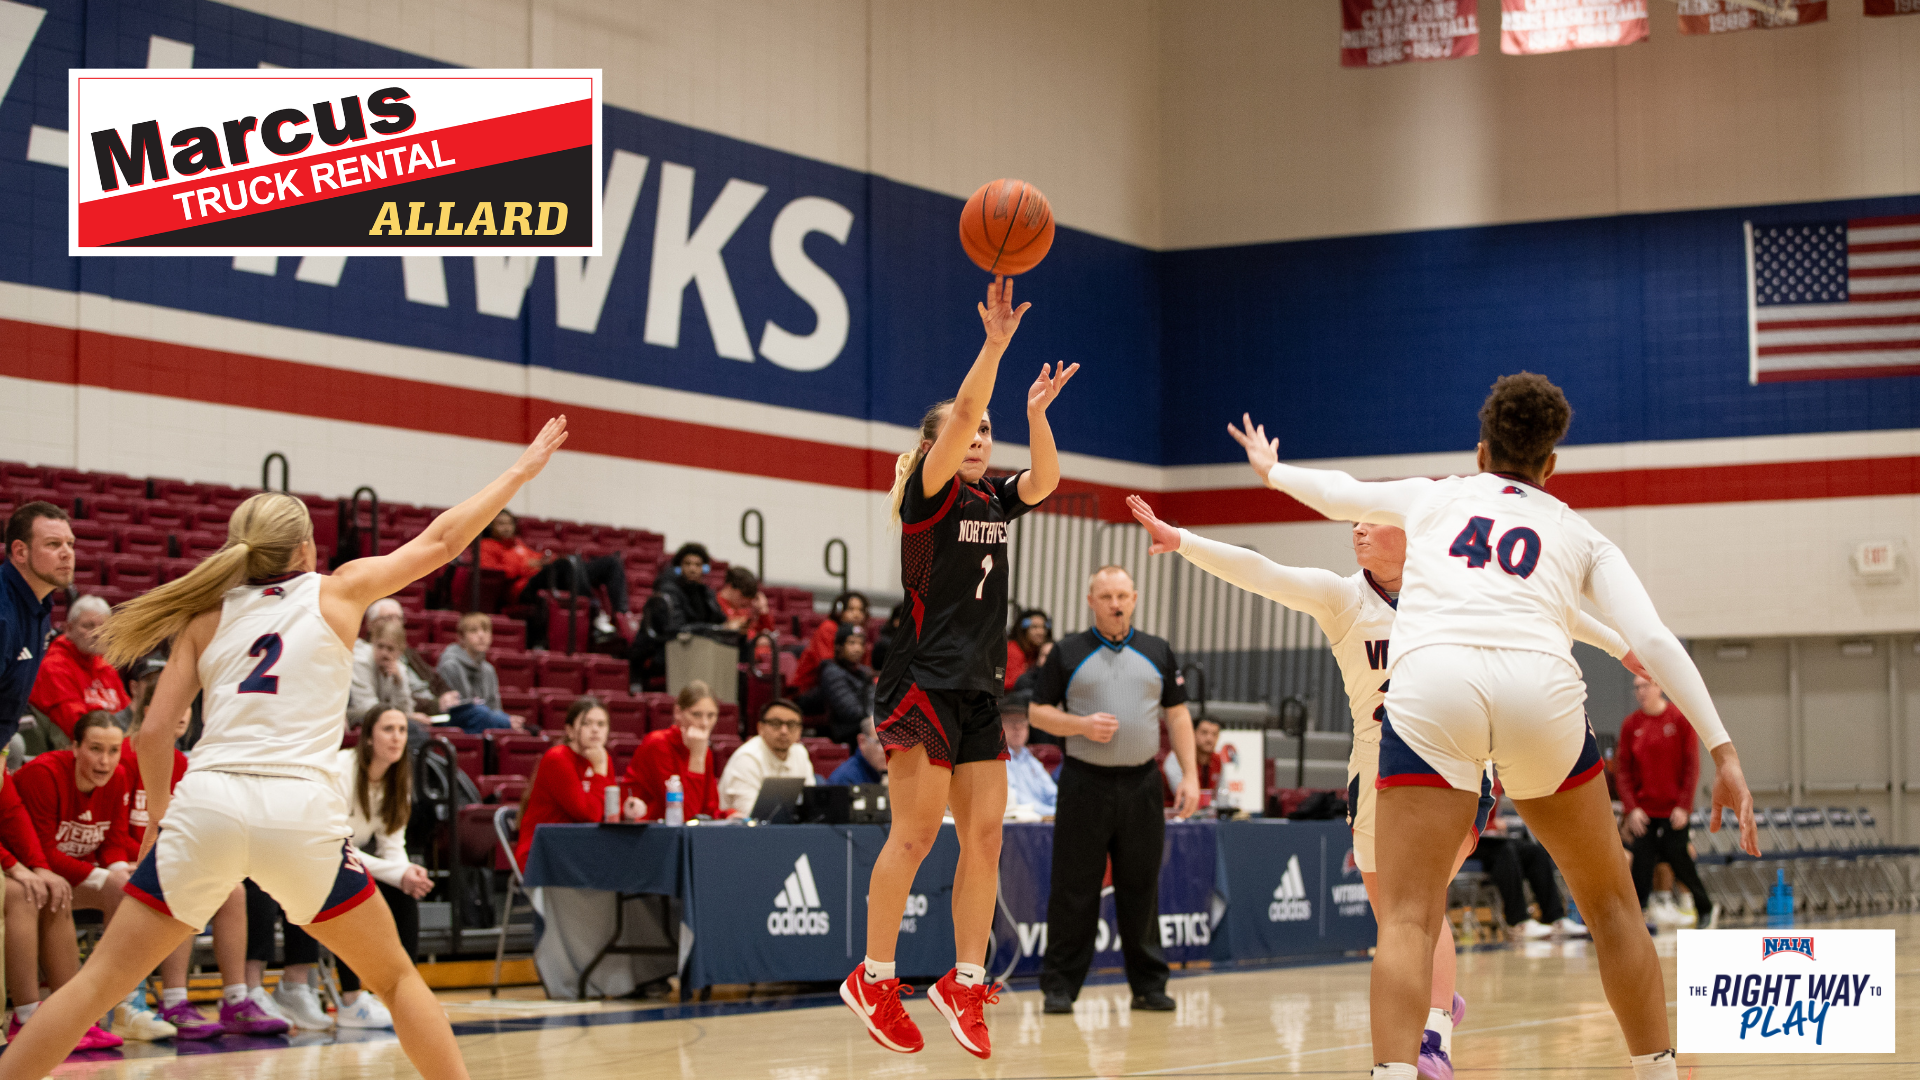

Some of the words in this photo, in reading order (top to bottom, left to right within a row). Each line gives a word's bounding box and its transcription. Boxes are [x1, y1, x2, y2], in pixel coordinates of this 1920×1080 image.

[1543, 2, 1649, 28] BASKETBALL
[1448, 515, 1542, 580] 40
[237, 632, 284, 694] 2
[767, 906, 830, 936] adidas
[1268, 898, 1312, 922] adidas
